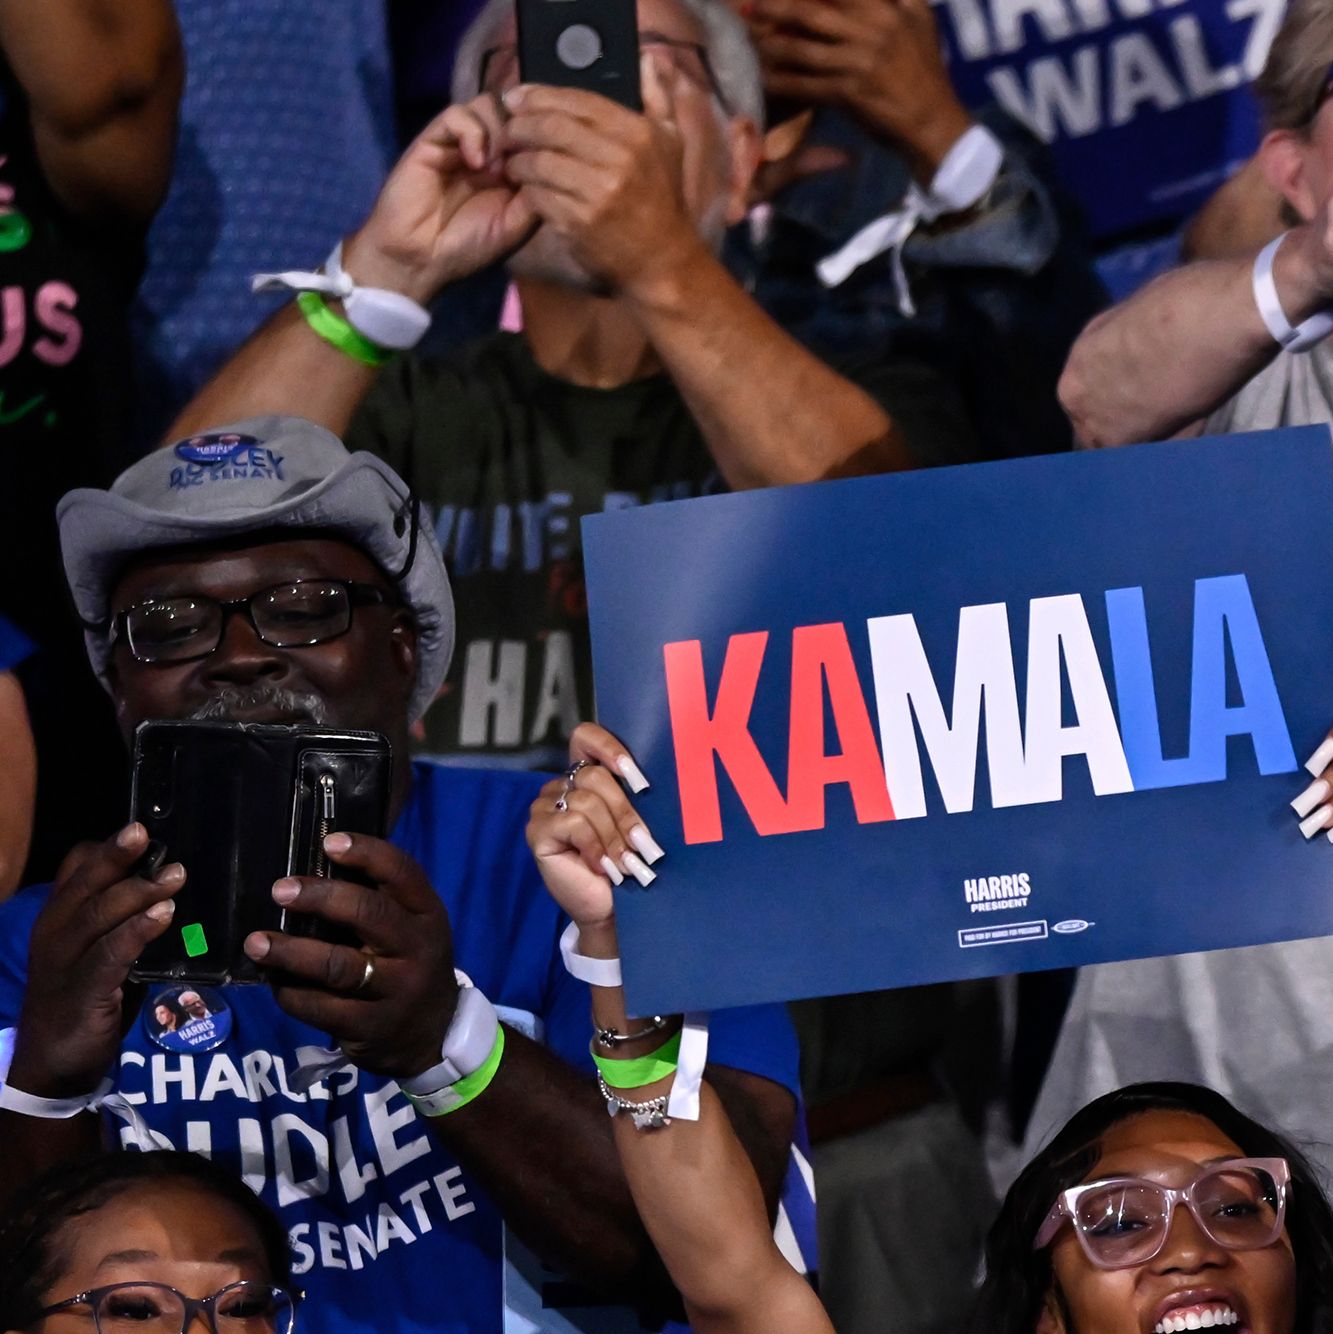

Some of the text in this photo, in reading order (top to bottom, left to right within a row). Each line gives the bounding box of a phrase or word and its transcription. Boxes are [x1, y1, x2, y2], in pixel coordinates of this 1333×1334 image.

[663, 573, 1299, 845] KAMALA
[963, 872, 1032, 903] HARRIS
[970, 897, 1029, 913] PRESIDENT
[178, 1019, 216, 1041] HARRIS
[288, 1165, 476, 1275] SENATE
